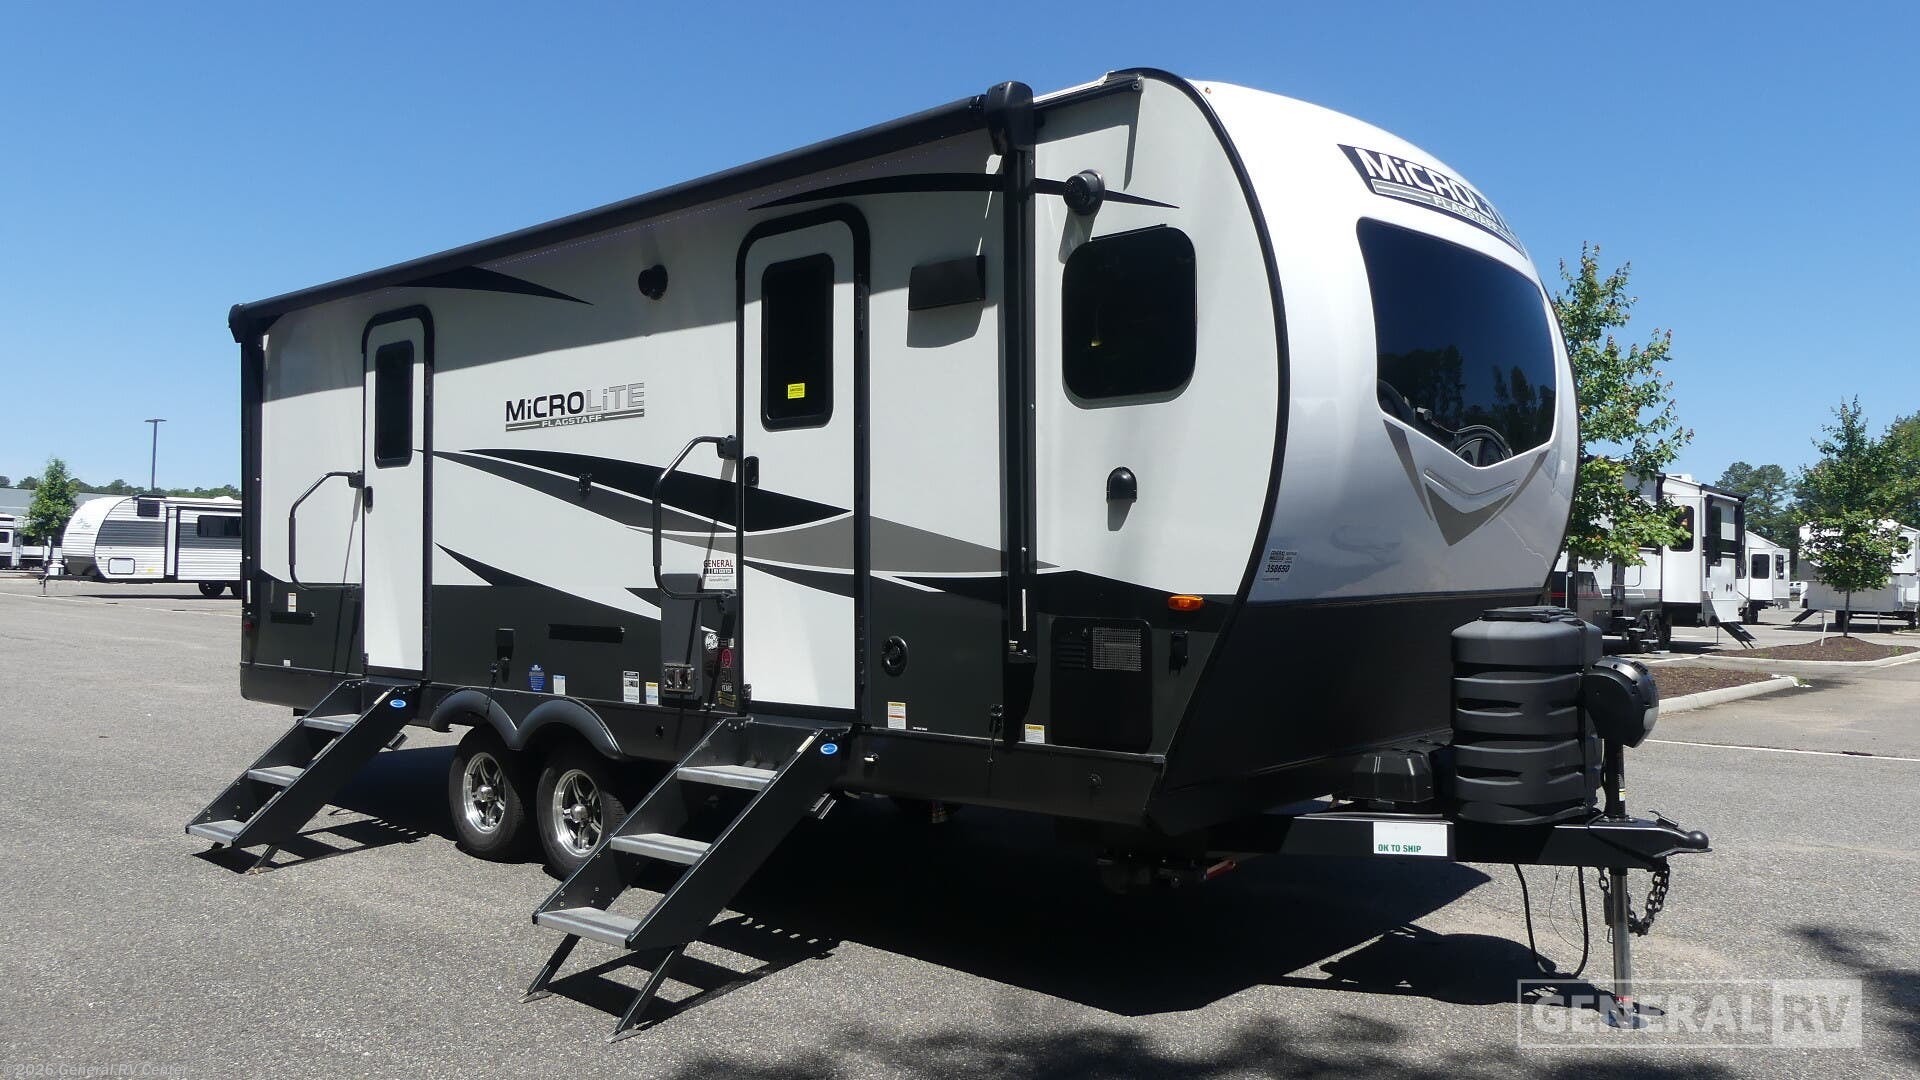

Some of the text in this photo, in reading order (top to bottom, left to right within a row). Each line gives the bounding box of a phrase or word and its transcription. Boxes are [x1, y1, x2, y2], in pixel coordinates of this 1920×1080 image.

[541, 414, 602, 428] FLAGSTAFF
[703, 559, 734, 568] GENERAL
[1378, 844, 1422, 853] OK TO SHIP
